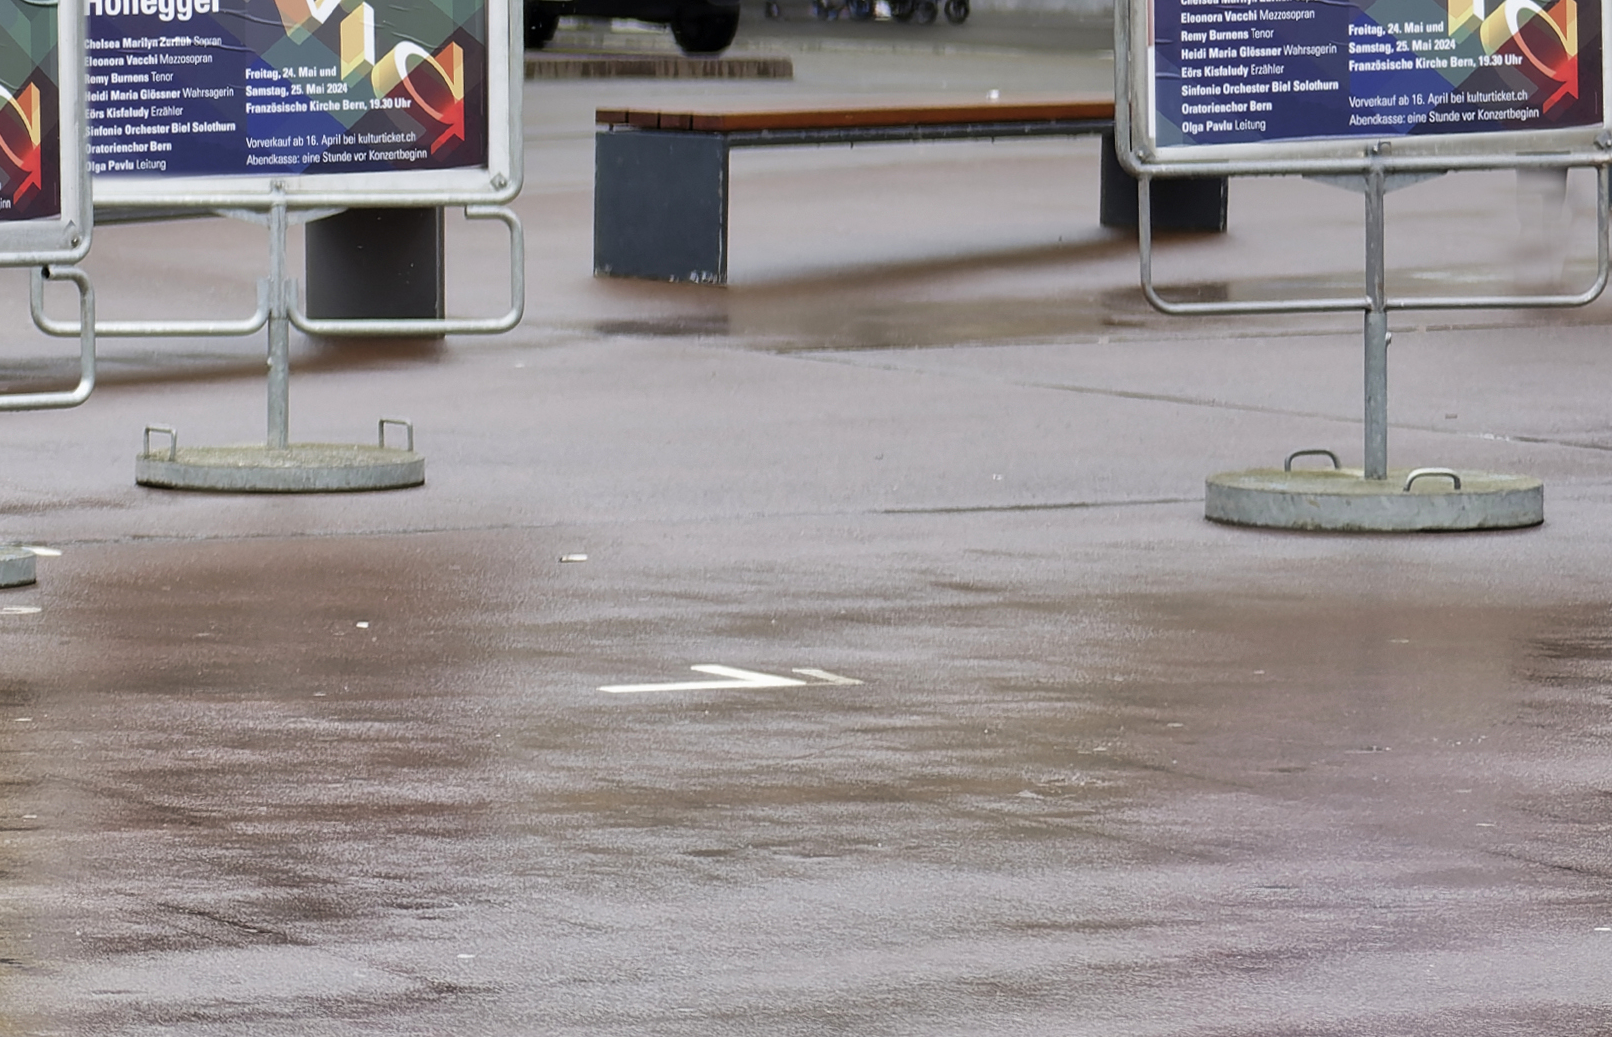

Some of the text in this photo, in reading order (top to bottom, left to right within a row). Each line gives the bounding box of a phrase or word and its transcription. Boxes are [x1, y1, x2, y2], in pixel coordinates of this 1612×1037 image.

[1180, 42, 1337, 60] Heidi Maria Glössner Wahrsagerin
[244, 65, 337, 81] Freitag, 24. Mai und
[1181, 118, 1266, 135] Olga Pavlu Leitung
